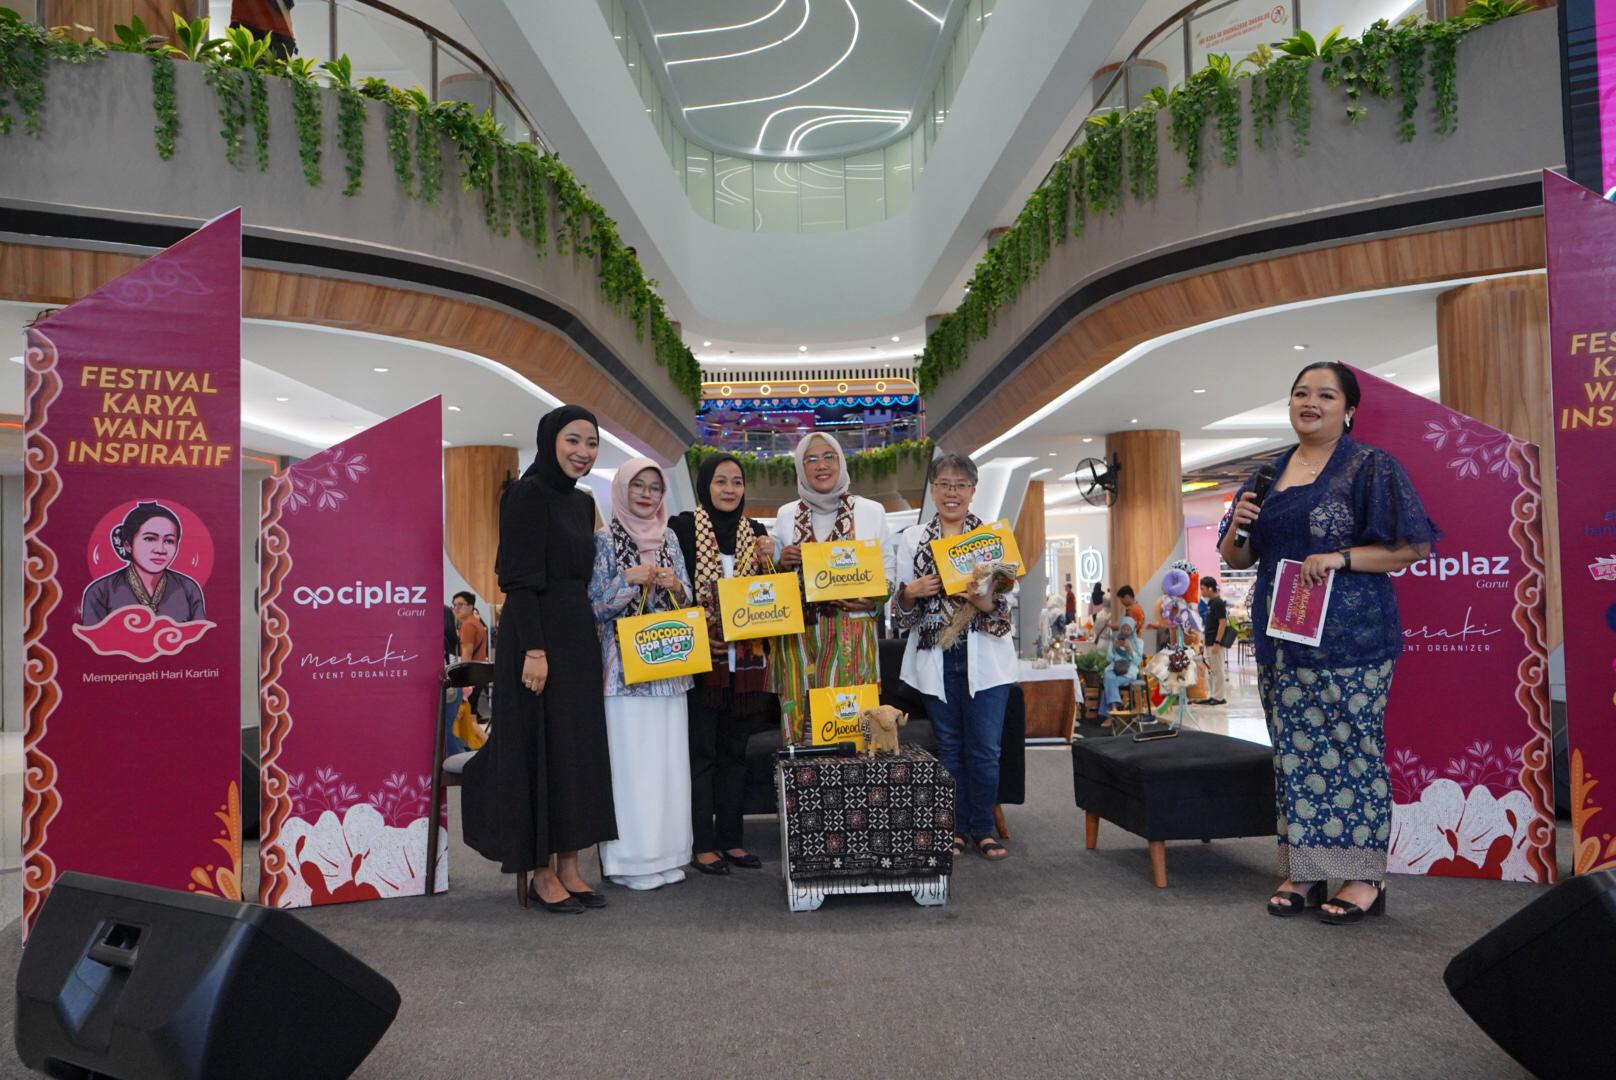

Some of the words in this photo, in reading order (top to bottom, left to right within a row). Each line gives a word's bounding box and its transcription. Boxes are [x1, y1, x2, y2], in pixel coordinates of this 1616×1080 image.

[1593, 356, 1616, 377] K
[80, 366, 217, 394] FESTIVAL
[102, 392, 198, 417] KARYA
[93, 416, 208, 442] WANITA
[67, 441, 232, 467] INSPIRATIF
[949, 536, 1002, 558] CHOCODOT
[1410, 551, 1510, 581] ciplaz
[815, 568, 874, 590] Chocodot
[1476, 579, 1510, 589] Garut
[337, 580, 427, 609] ciplaz
[397, 607, 427, 617] Garut
[732, 604, 791, 628] Chocodot
[1402, 606, 1502, 641] eraki
[636, 627, 693, 645] CHOCODOT
[641, 640, 660, 654] FOR
[661, 634, 692, 646] EVERY
[301, 633, 418, 668] meraki
[651, 640, 691, 661] MOOD
[1427, 644, 1490, 652] ORGANIZER
[82, 670, 159, 683] Memperingati
[161, 669, 183, 680] Hari
[185, 668, 219, 678] Kartini
[312, 671, 345, 680] EVENT
[351, 669, 408, 679] ORGANIZER
[821, 718, 862, 742] Chocod
